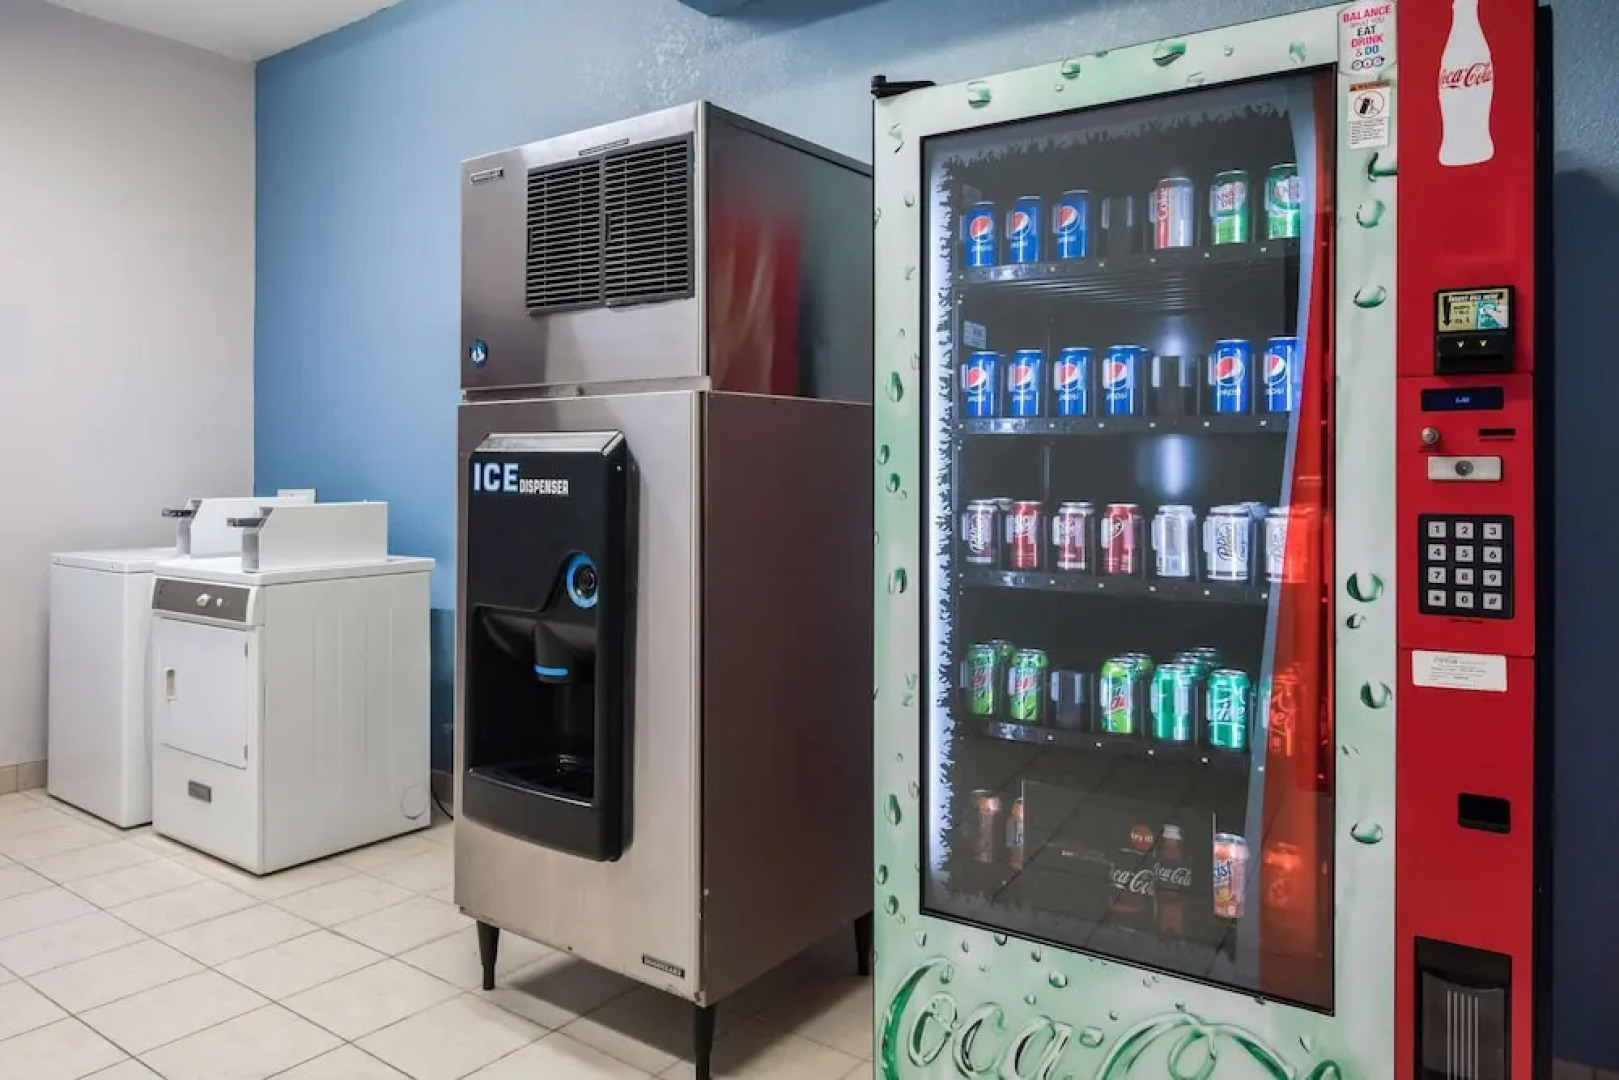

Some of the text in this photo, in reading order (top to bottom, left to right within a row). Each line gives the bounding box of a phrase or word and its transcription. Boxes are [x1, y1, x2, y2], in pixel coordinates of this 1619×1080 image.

[1343, 4, 1391, 23] BALANCE
[1357, 25, 1376, 37] EAT
[1351, 33, 1384, 48] DRINK
[1364, 44, 1379, 56] DO
[473, 462, 519, 493] ICE
[519, 478, 569, 496] DISPENSER
